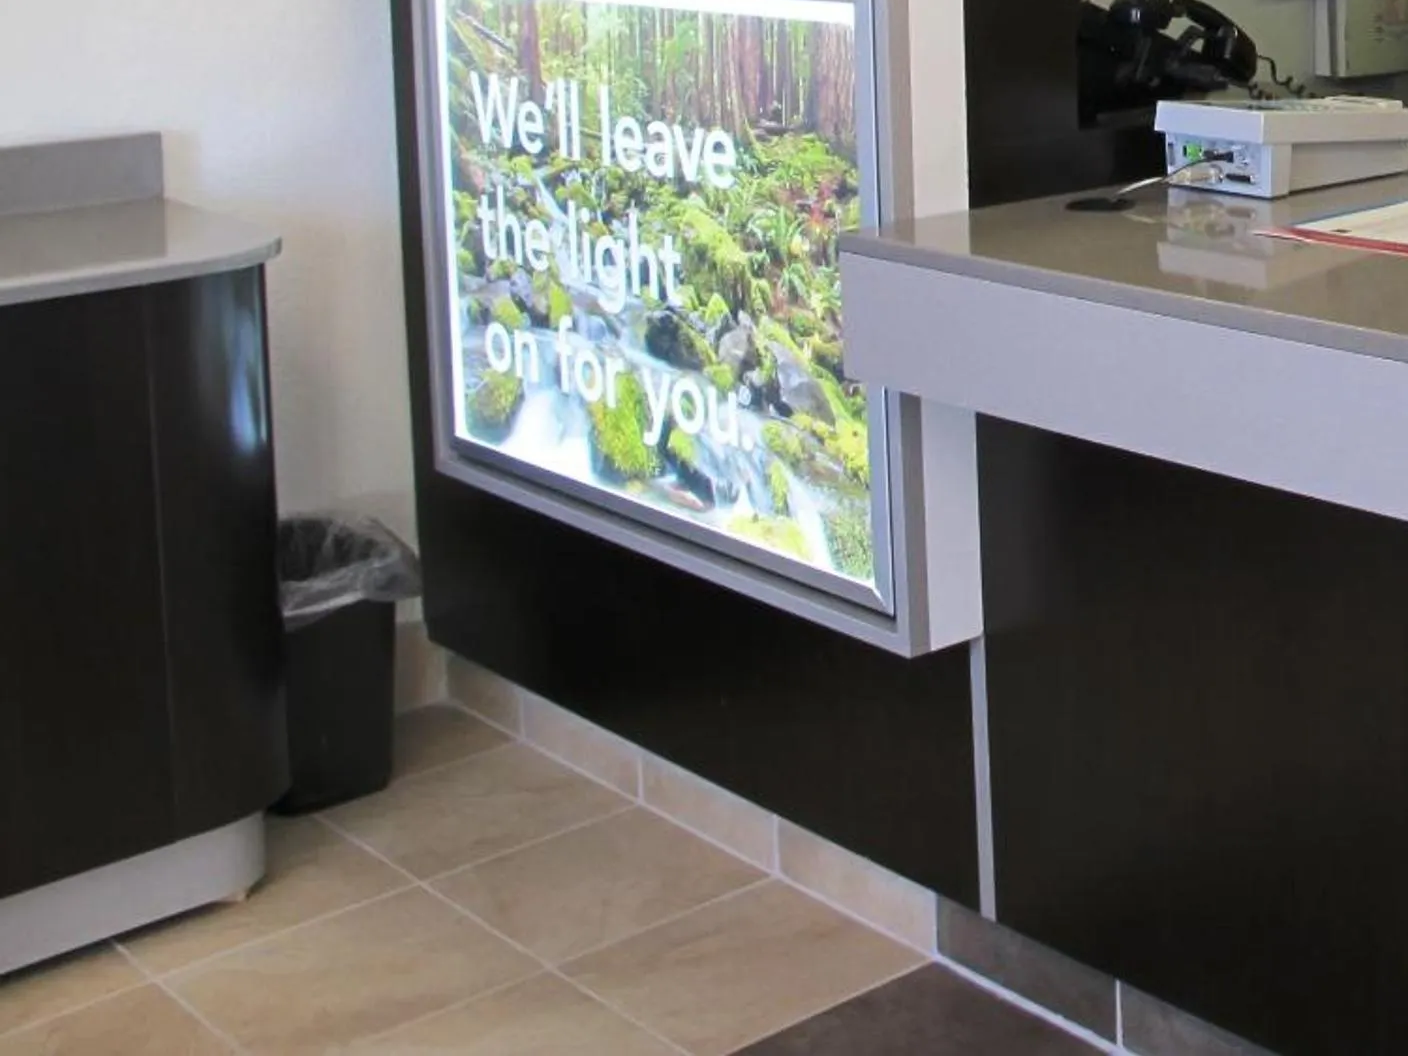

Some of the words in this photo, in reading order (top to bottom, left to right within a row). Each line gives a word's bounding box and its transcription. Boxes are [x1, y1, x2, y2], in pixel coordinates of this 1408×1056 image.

[469, 71, 581, 161] We'll
[599, 82, 736, 190] leave
[477, 184, 550, 271] the
[566, 198, 682, 315] light
[484, 322, 540, 382] on
[556, 315, 624, 409] for
